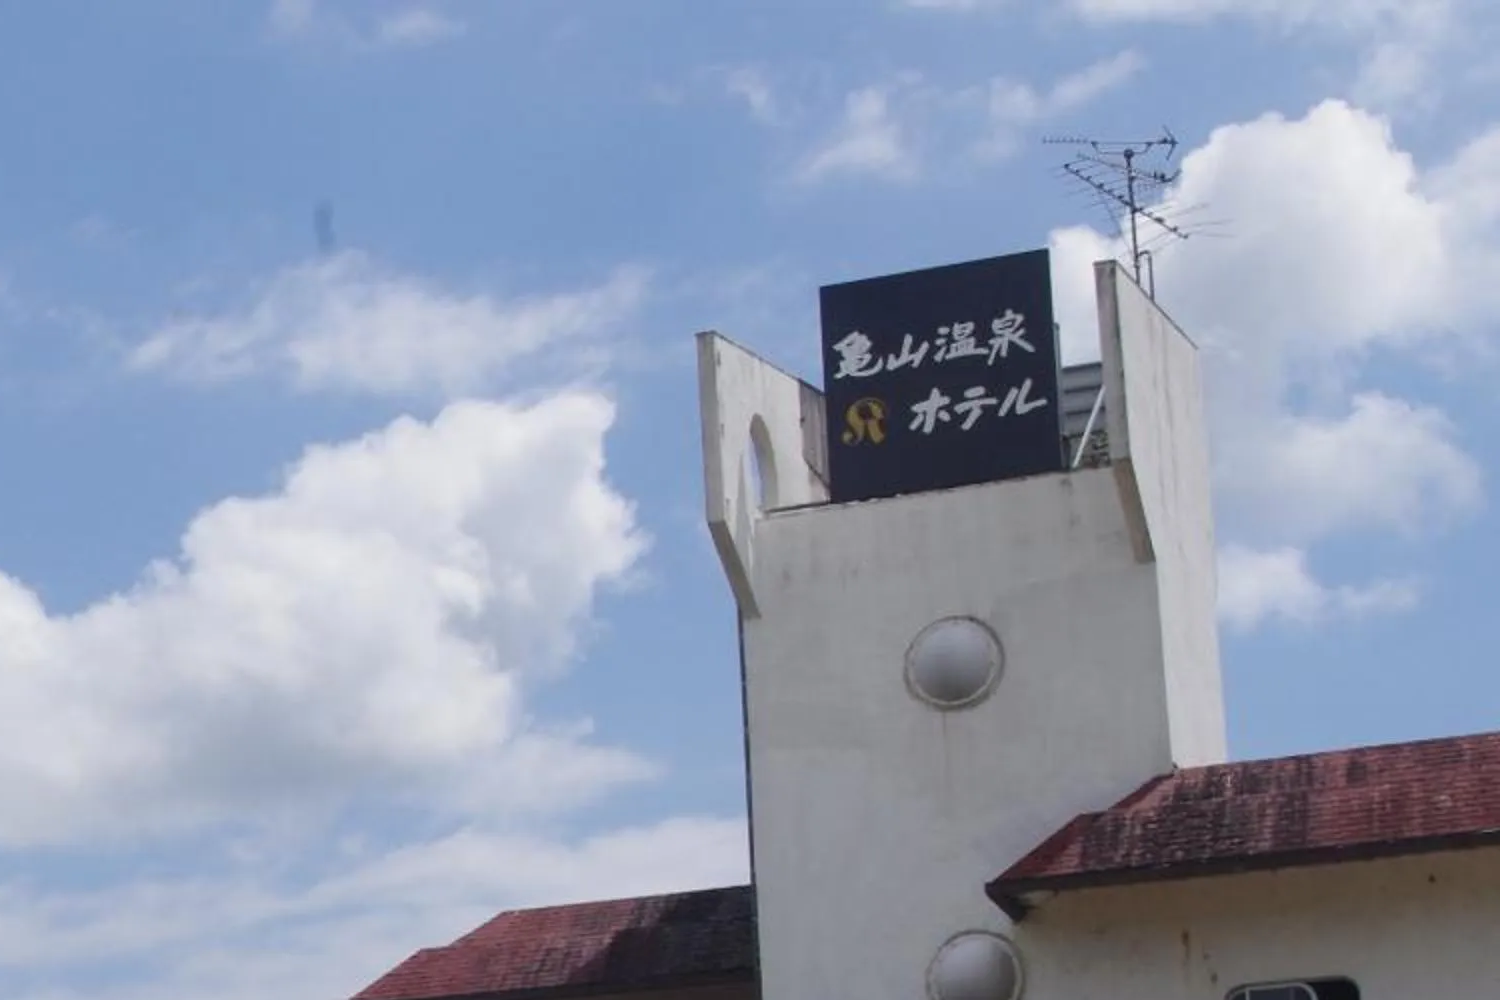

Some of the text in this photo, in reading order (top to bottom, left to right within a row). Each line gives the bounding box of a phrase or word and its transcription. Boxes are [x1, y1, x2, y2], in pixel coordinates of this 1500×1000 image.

[832, 308, 1036, 379] 亀山温泉
[908, 378, 1048, 434] ホテル
